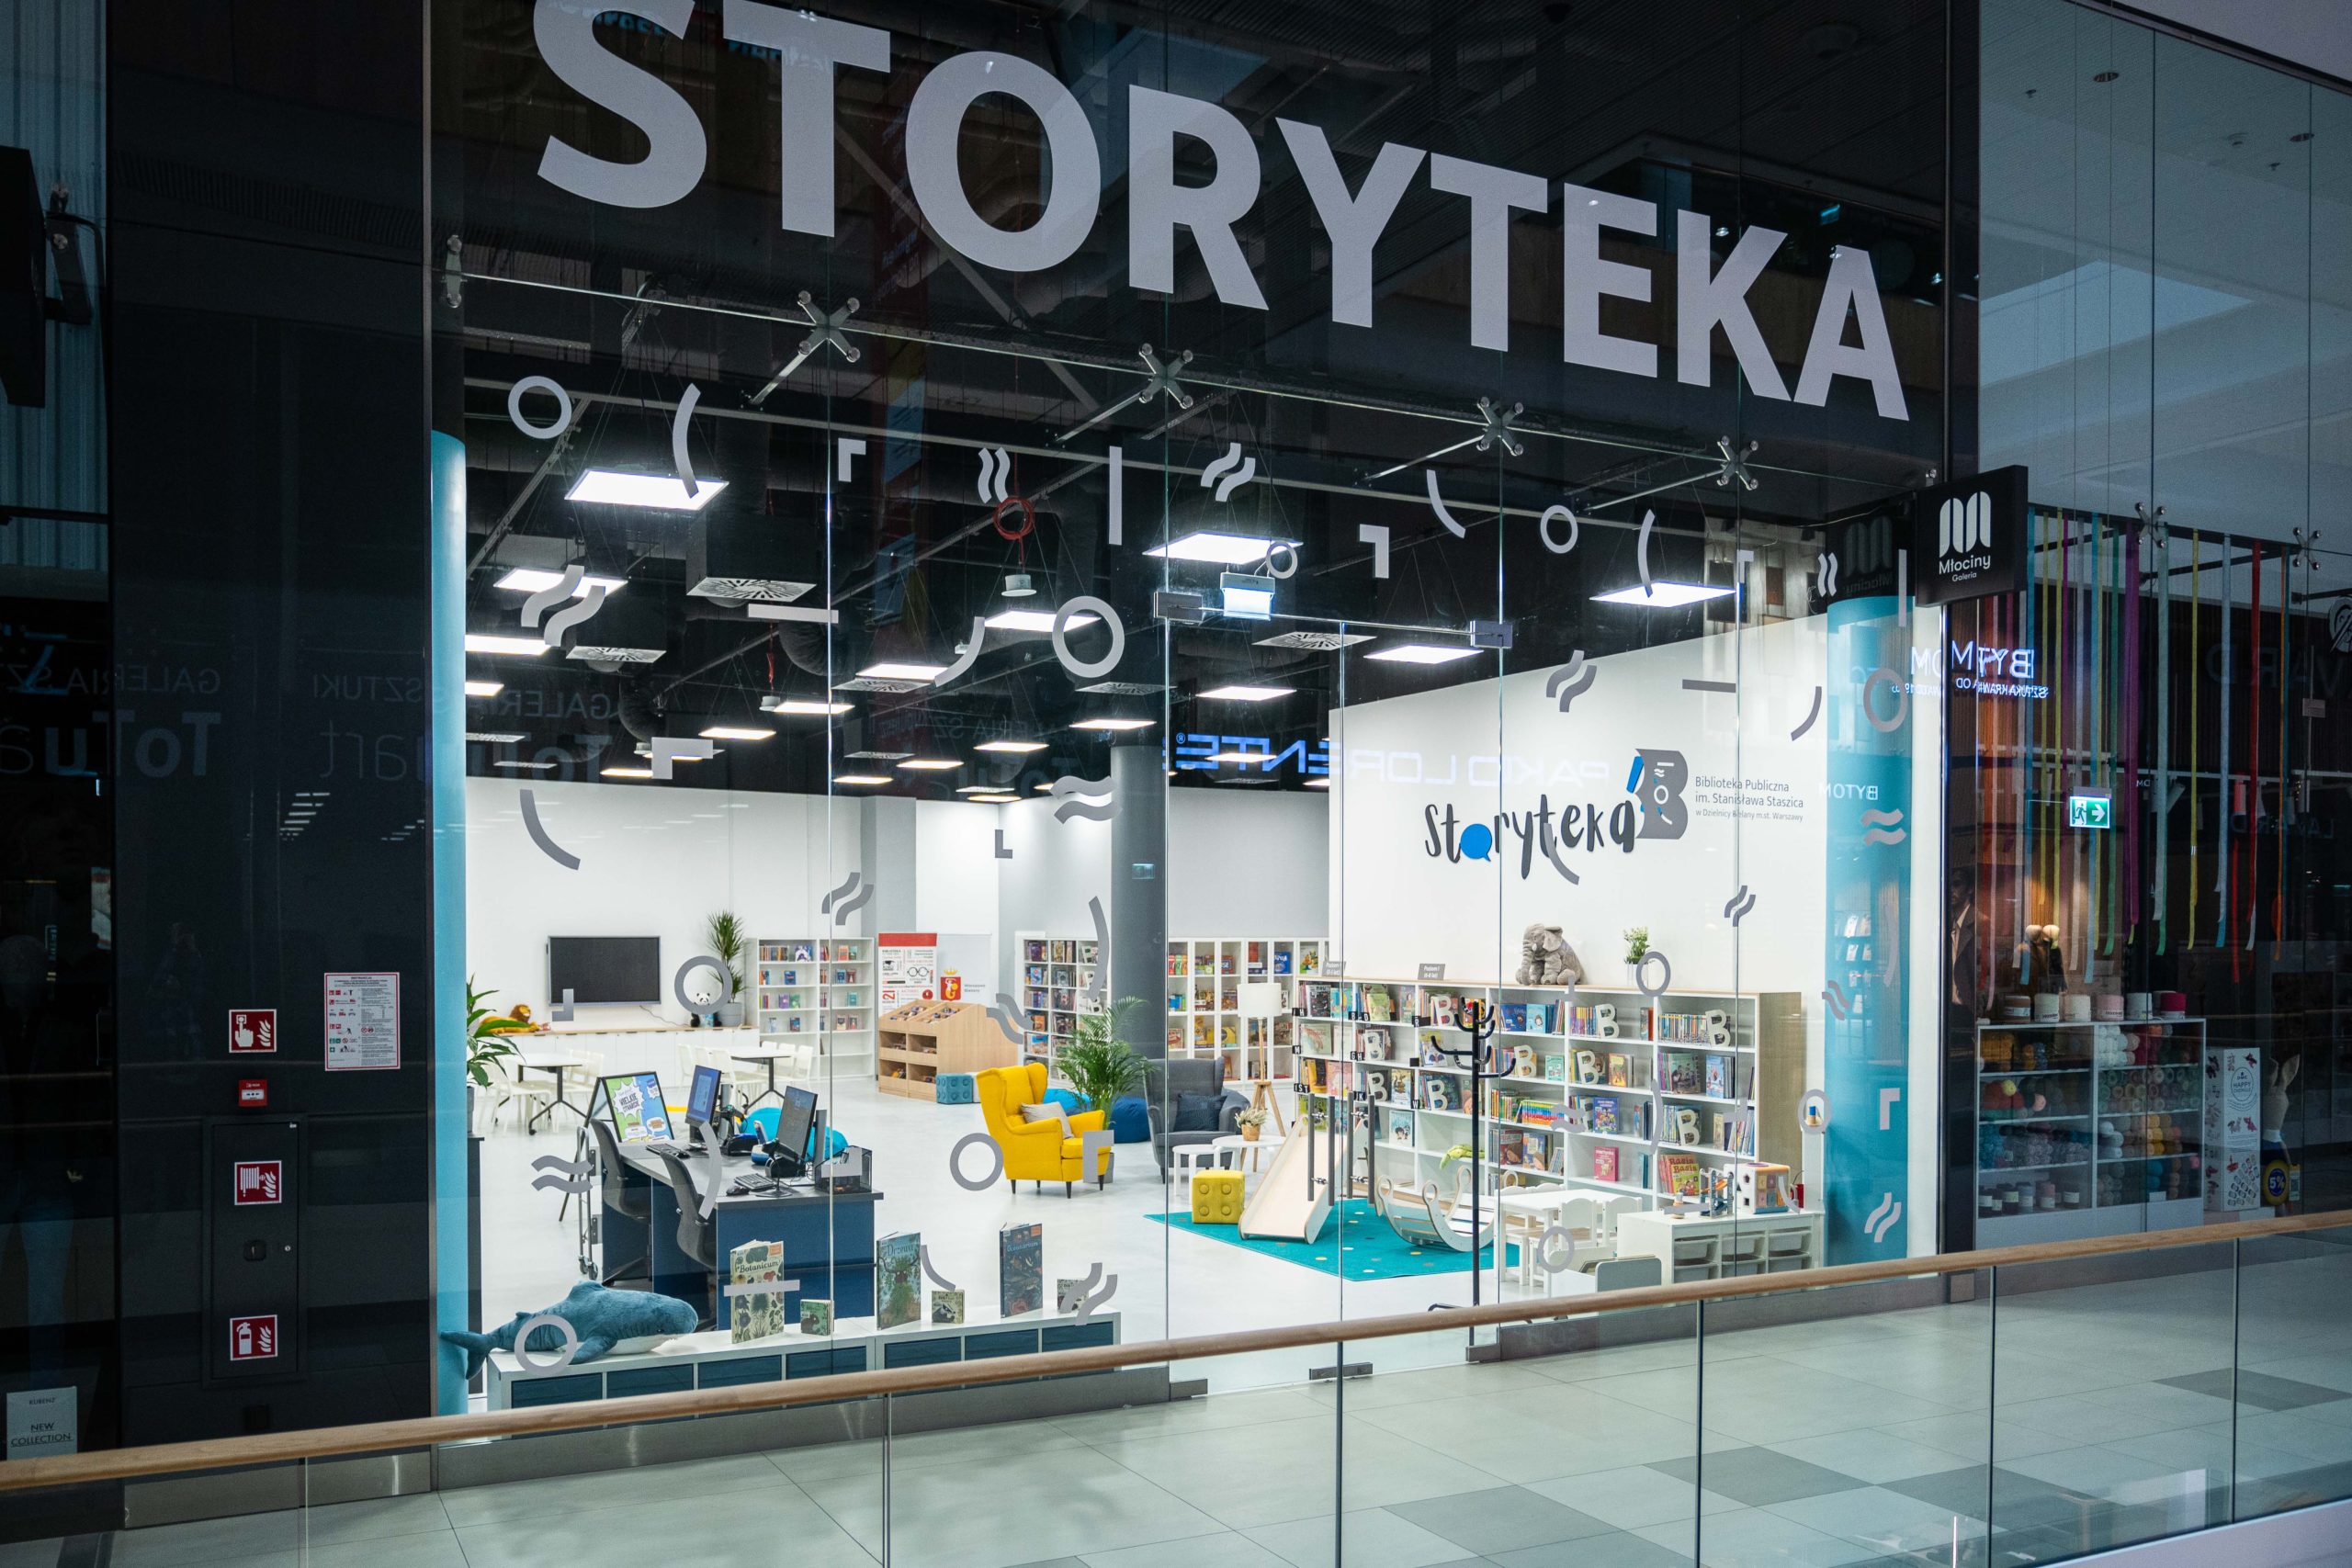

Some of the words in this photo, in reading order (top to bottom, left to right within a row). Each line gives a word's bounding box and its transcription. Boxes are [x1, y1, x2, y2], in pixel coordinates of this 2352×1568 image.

[533, 0, 1909, 422] STORYTEKA
[1939, 554, 1991, 575] Młociny
[1951, 570, 1977, 582] Galeria
[1695, 776, 1743, 790] Biblioteka
[1746, 779, 1790, 793] Publiczna
[1695, 793, 1711, 804] im.
[1713, 793, 1765, 807] Stanisława
[1767, 795, 1804, 808] Staszica
[1702, 809, 1731, 819] Dzielnicy
[1772, 812, 1804, 823] Warszawy
[2268, 1173, 2286, 1190] 5%
[740, 1260, 779, 1273] Botanicum
[30, 1422, 55, 1432] NEW
[10, 1432, 72, 1447] COLLECTION
